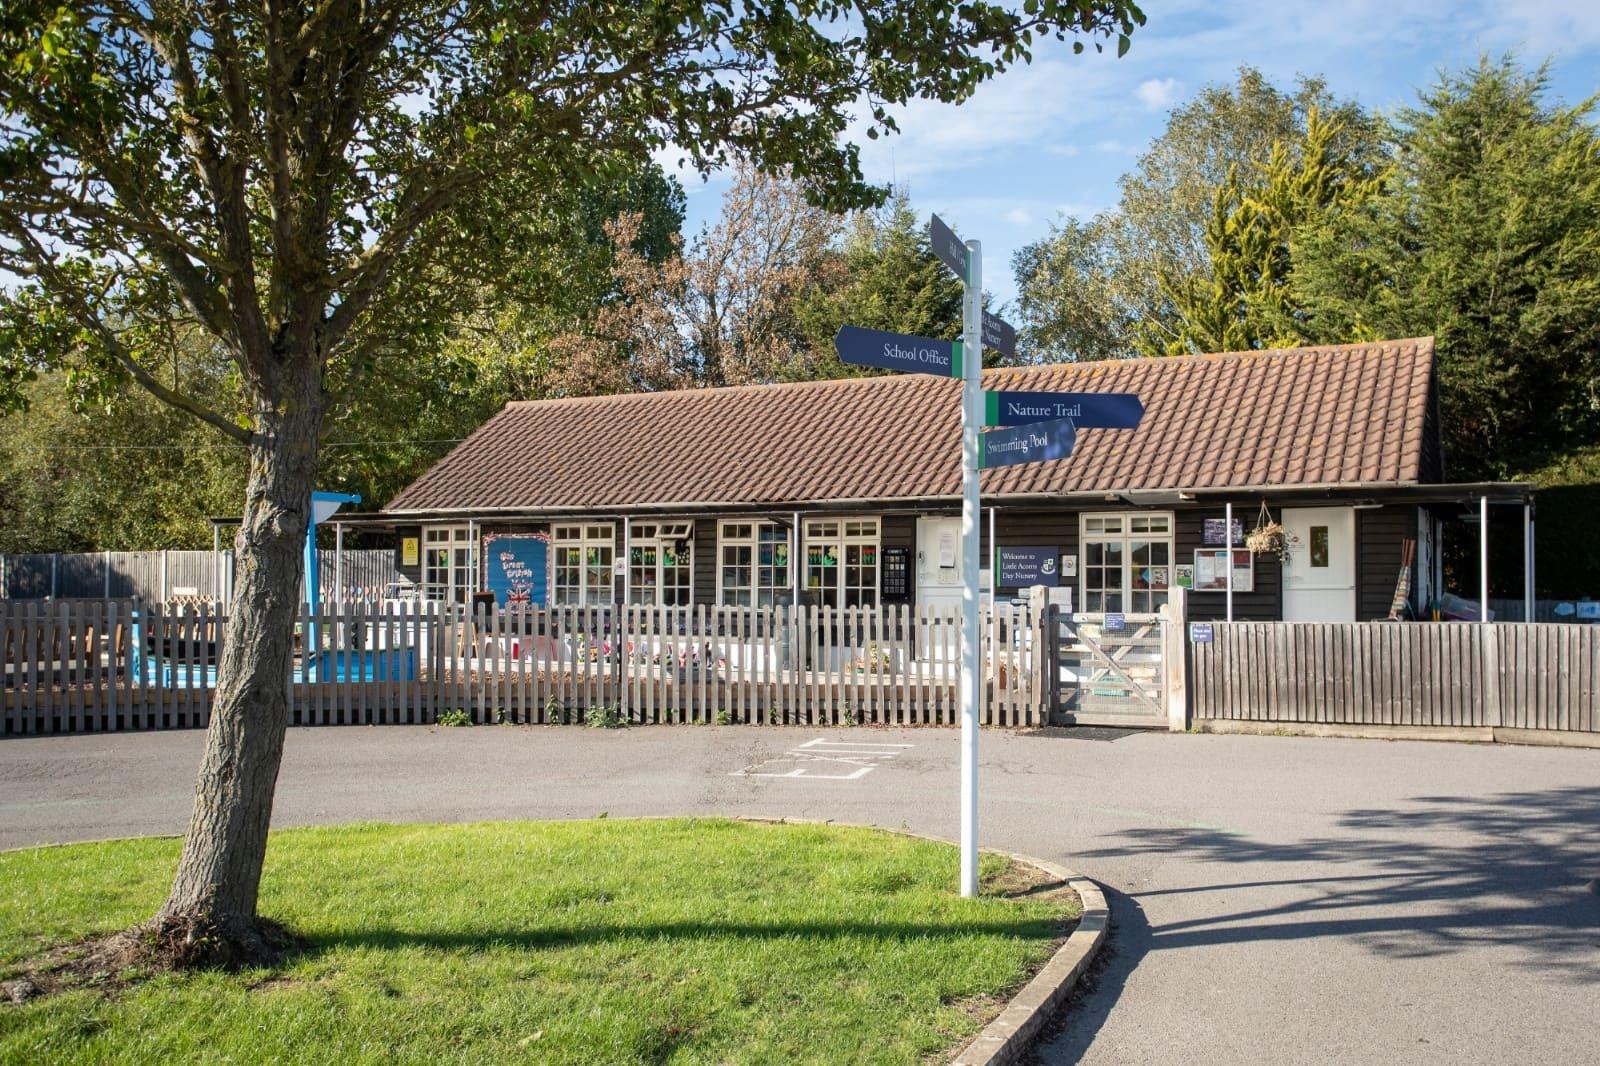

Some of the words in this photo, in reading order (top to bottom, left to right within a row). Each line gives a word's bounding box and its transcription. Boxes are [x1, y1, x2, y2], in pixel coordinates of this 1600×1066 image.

[883, 343, 917, 361] School
[919, 349, 949, 366] Office
[1008, 402, 1051, 416] Nature
[1053, 403, 1081, 417] Trail
[987, 437, 1028, 454] Swimming
[1029, 432, 1048, 448] Pool
[1002, 552, 1028, 560] Welcome
[1002, 562, 1017, 570] Little
[1018, 562, 1038, 570] Acorns
[1002, 572, 1014, 580] Day
[1015, 572, 1038, 580] Nursery
